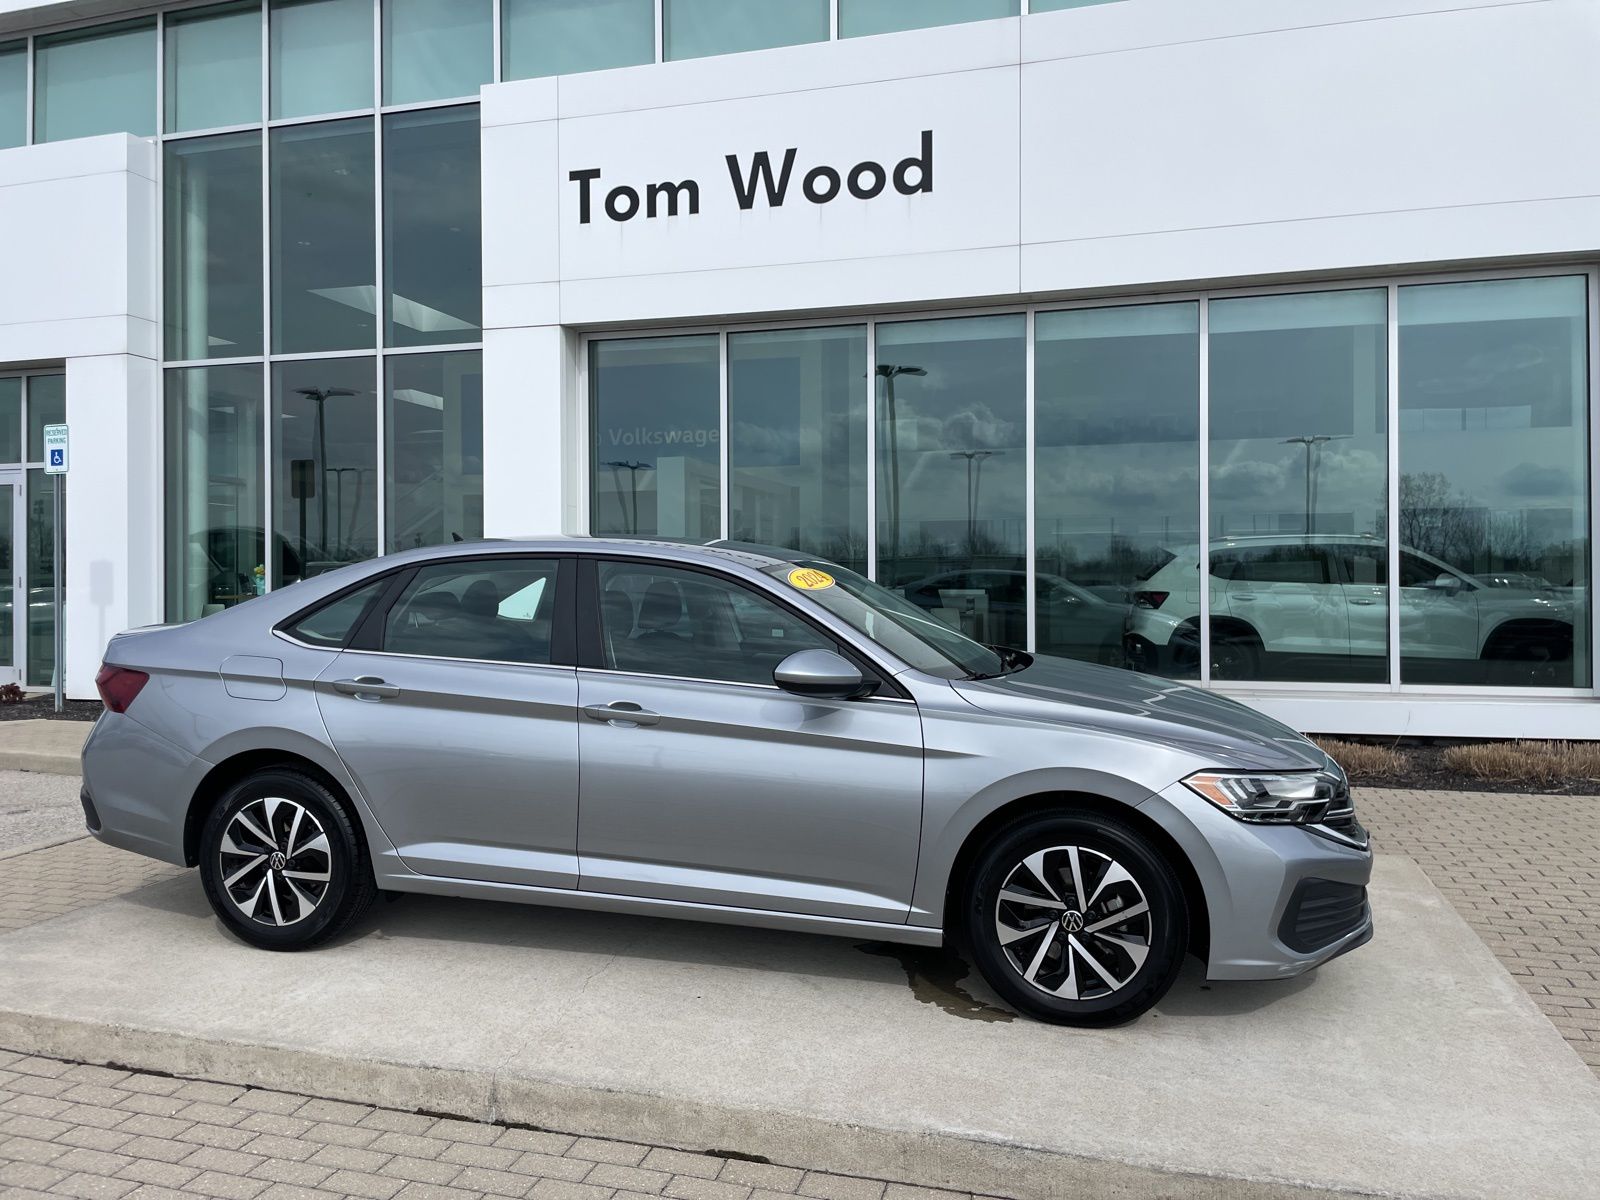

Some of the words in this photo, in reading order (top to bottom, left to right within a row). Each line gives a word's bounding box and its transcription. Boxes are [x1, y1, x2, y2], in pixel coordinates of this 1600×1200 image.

[569, 168, 699, 224] Tom
[725, 130, 933, 211] Wood
[608, 427, 720, 447] Volkswage
[796, 570, 829, 587] 2024
